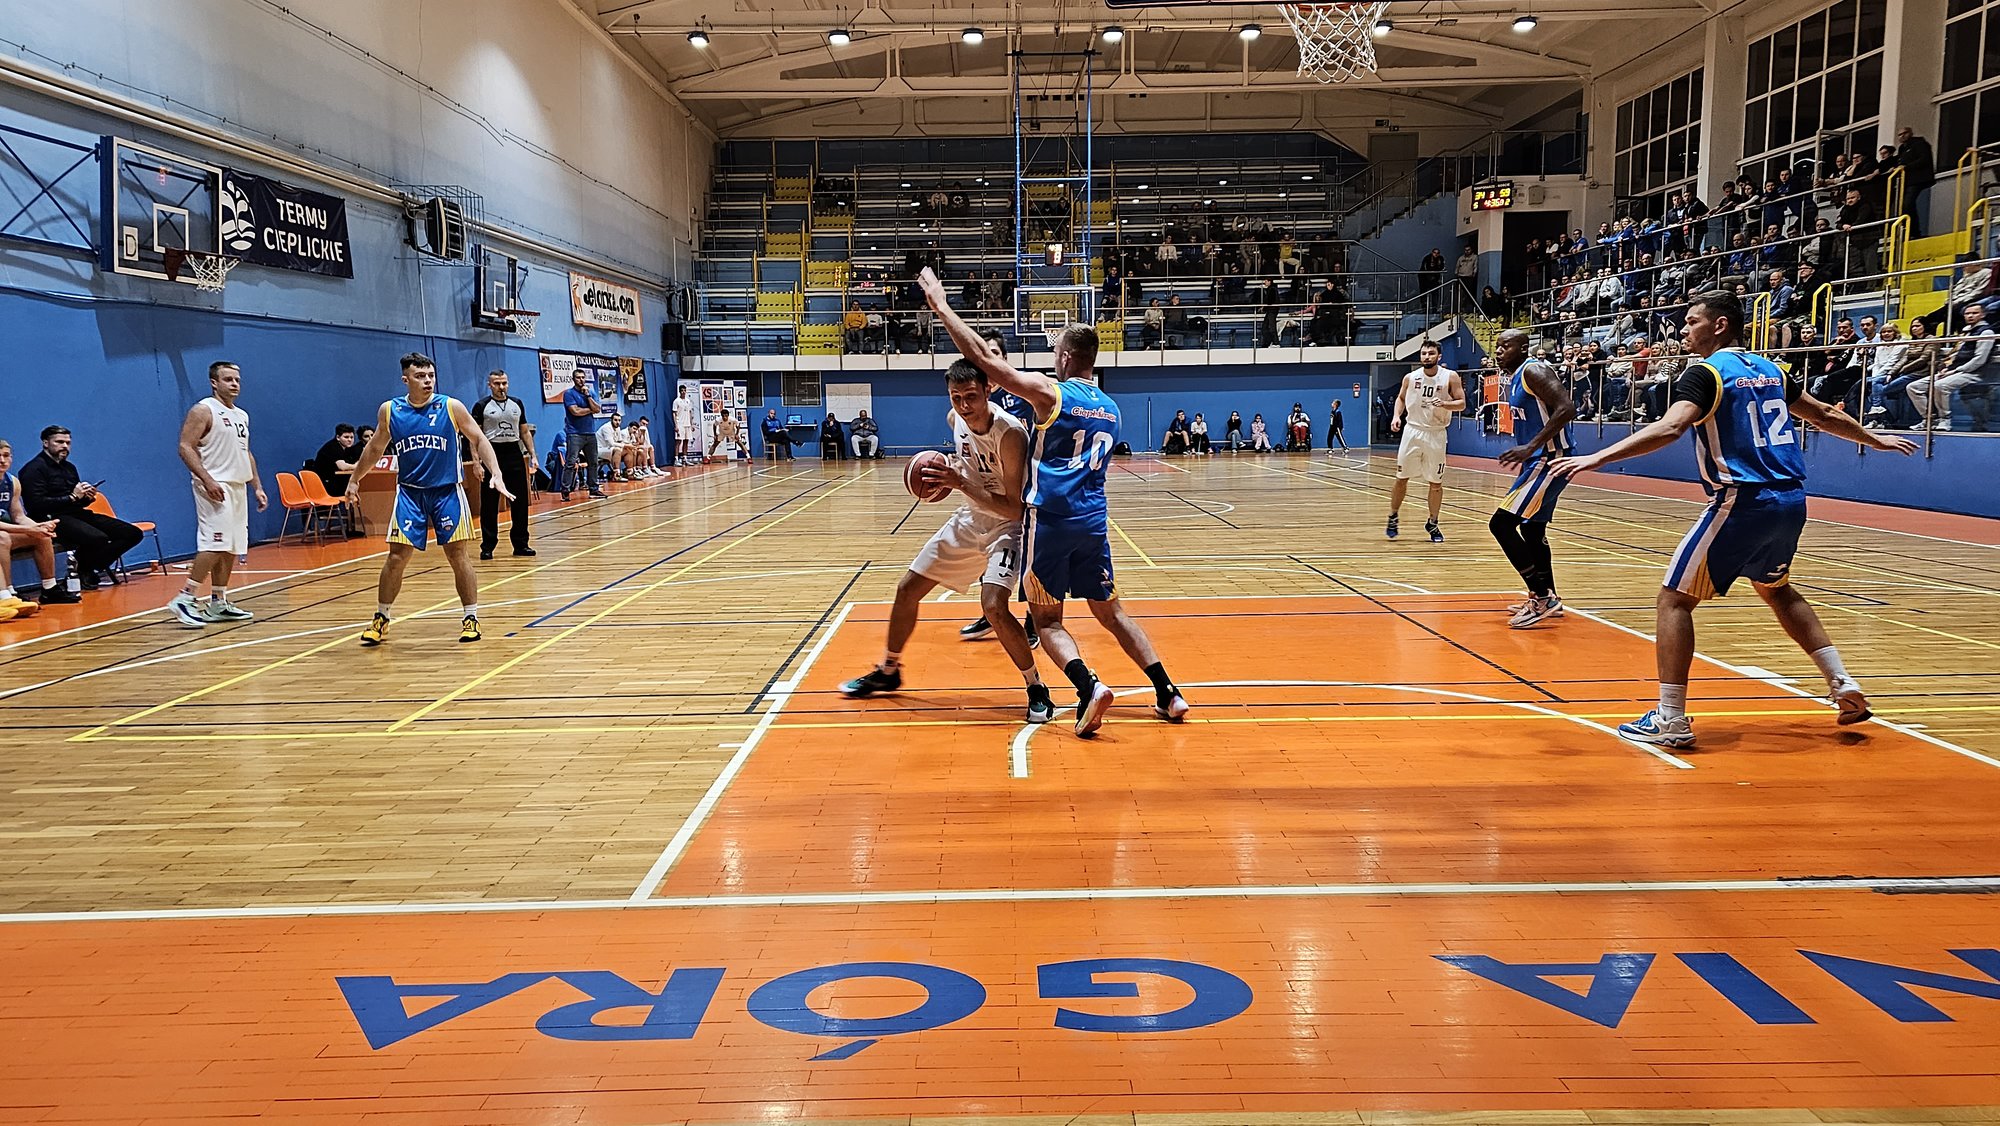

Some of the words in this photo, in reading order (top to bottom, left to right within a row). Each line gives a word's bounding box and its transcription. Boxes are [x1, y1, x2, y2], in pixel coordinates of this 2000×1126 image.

[276, 198, 327, 231] TERMY
[263, 227, 344, 263] CIEPLICKIE
[1002, 395, 1015, 409] 15
[1422, 386, 1434, 397] 10
[234, 423, 246, 438] 12
[428, 414, 437, 426] 7
[1745, 399, 1795, 447] 12
[1068, 429, 1113, 470] 10
[976, 453, 992, 472] 11
[403, 519, 412, 532] 7
[999, 548, 1016, 571] 11
[334, 957, 1254, 1063] GÓRA
